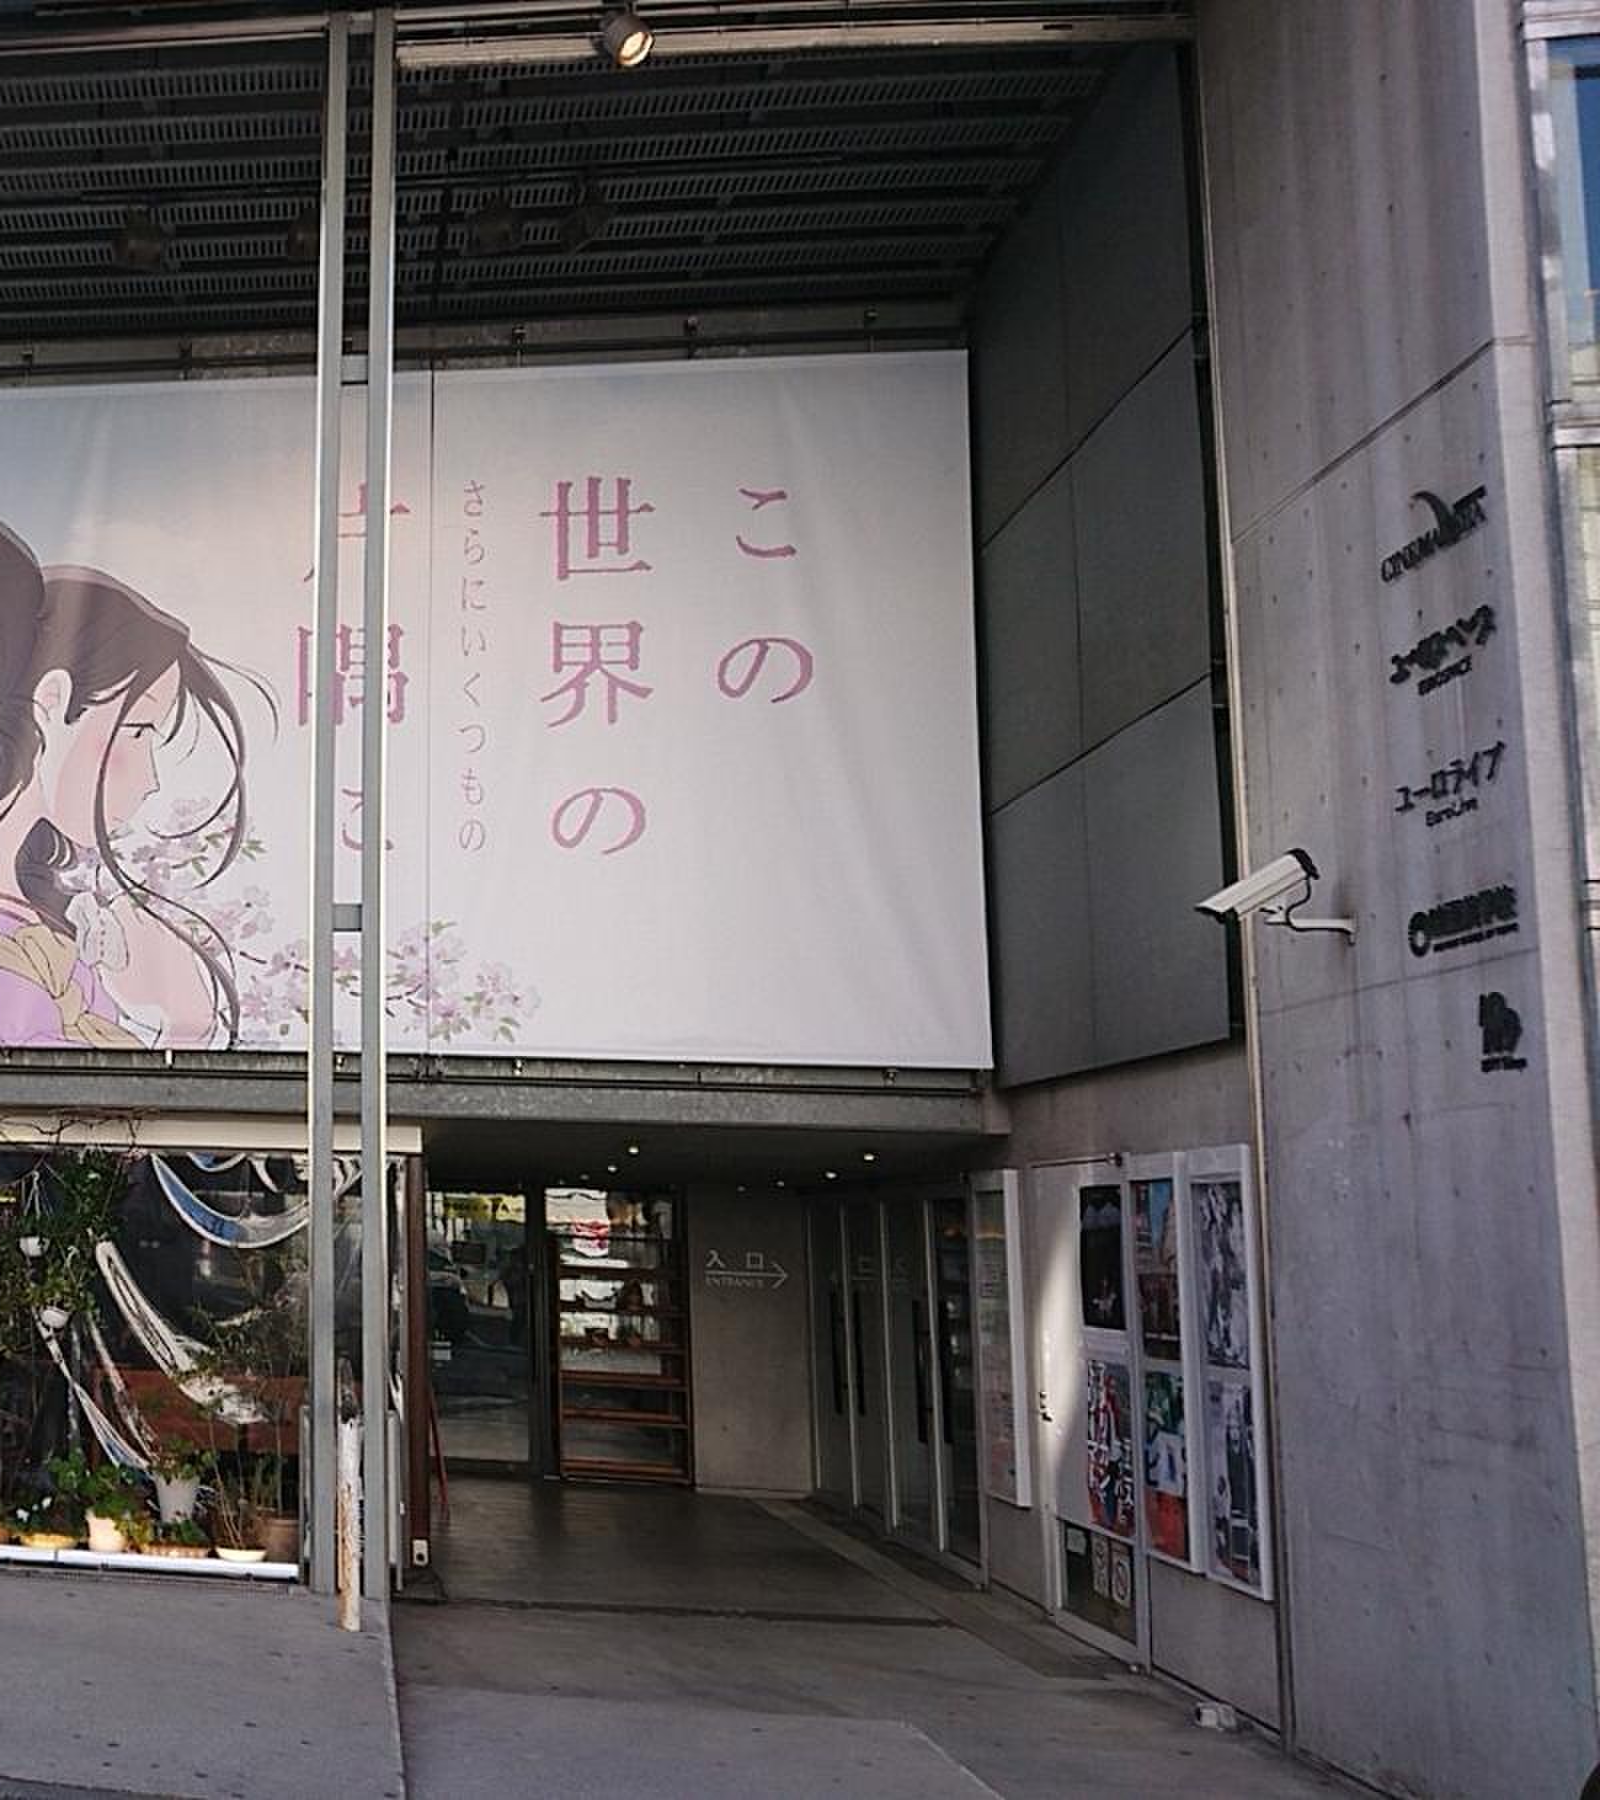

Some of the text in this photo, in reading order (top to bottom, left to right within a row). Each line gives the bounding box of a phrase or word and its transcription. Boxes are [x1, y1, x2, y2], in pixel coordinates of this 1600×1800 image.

[459, 479, 487, 853] さらにいくつもの
[538, 475, 656, 856] 世界の
[716, 487, 814, 704] この
[705, 1249, 764, 1270] 入口
